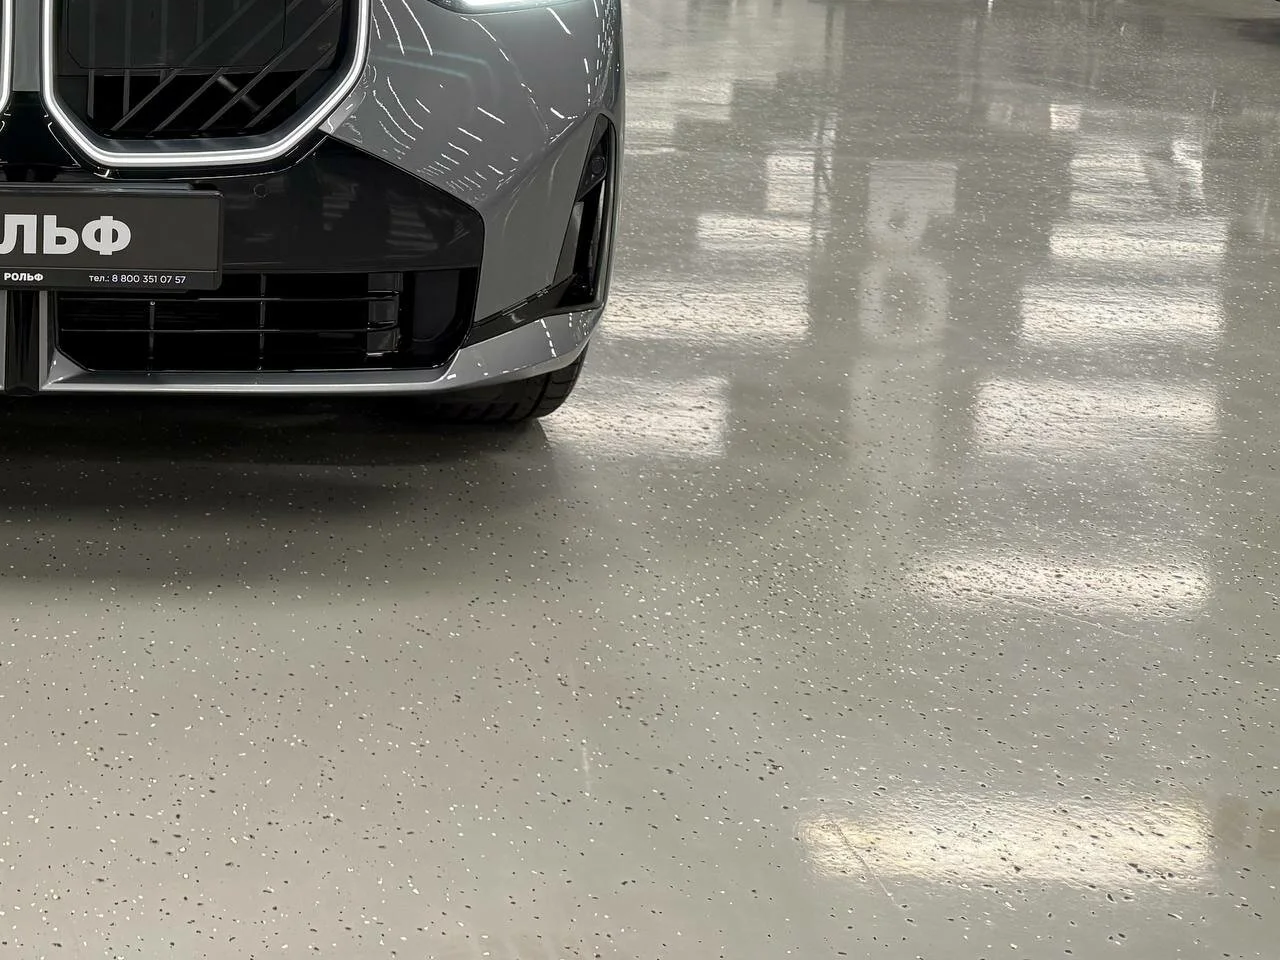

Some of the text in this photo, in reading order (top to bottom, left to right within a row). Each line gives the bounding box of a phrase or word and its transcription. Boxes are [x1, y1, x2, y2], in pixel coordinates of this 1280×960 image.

[3, 272, 44, 282] РОЛЬФ
[111, 274, 118, 283] 8
[120, 274, 140, 284] 800
[142, 275, 158, 283] 351
[160, 275, 172, 284] 07
[174, 275, 186, 284] 57
